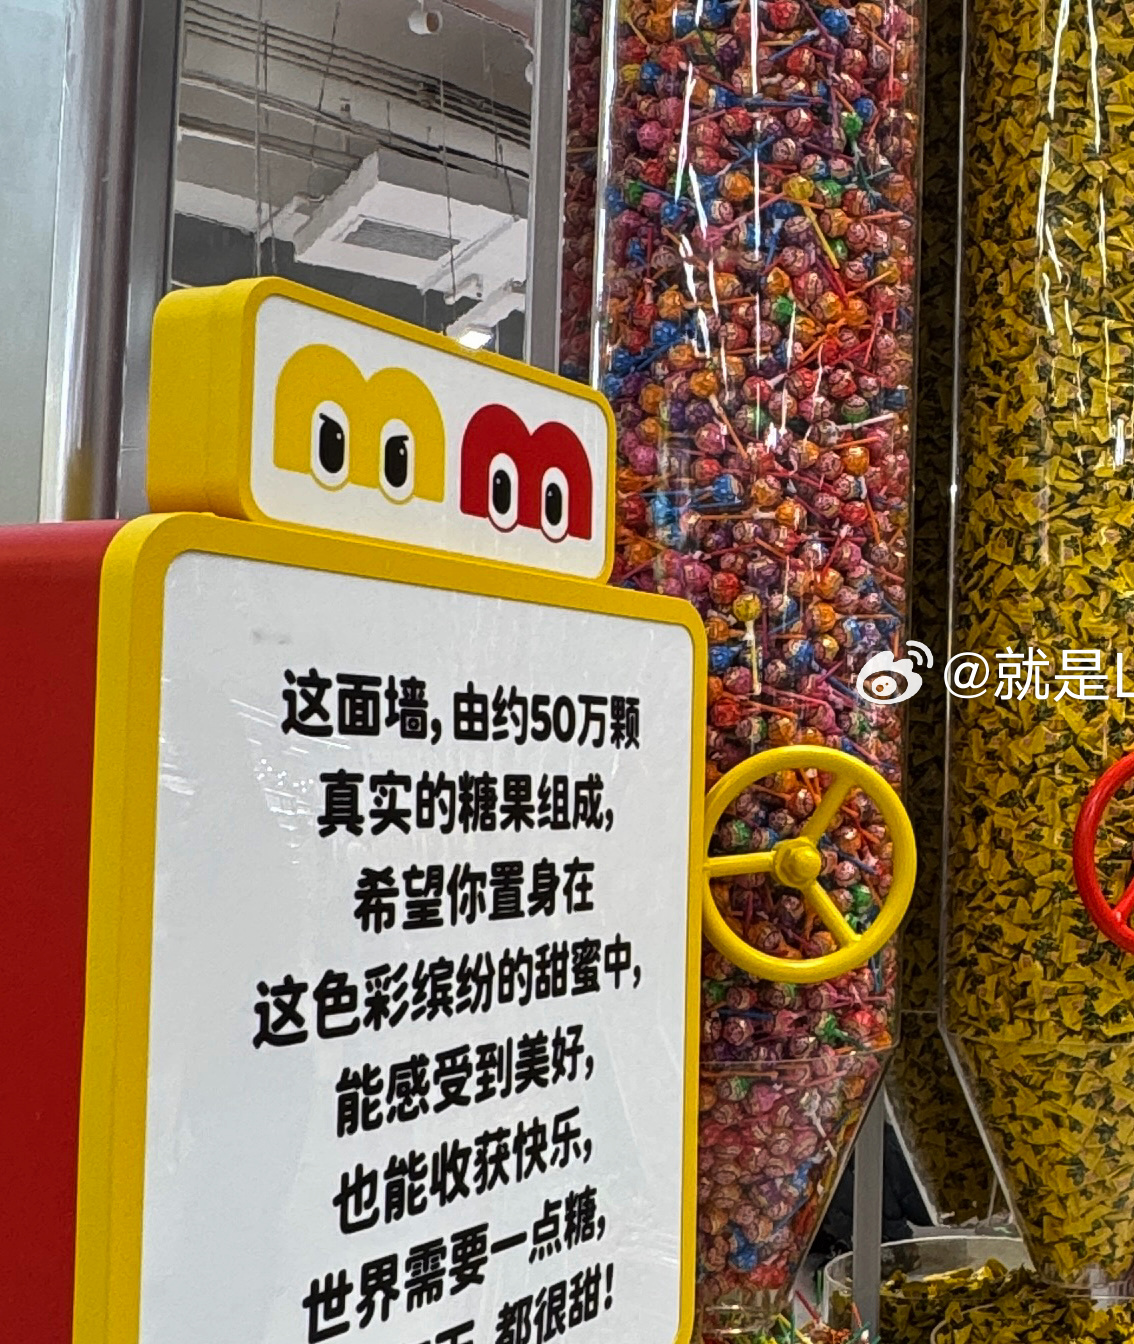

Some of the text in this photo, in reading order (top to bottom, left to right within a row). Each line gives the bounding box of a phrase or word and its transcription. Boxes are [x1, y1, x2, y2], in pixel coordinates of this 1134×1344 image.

[317, 768, 614, 838] 真实的糖果组成，
[353, 856, 595, 934] 希望你置身在
[252, 933, 641, 1050] 这色彩缤纷的甜蜜中，
[335, 1024, 594, 1138] 能感受到美好，
[332, 1106, 593, 1235] 也能收获快乐，
[302, 1184, 606, 1344] 世界需要一点糖，
